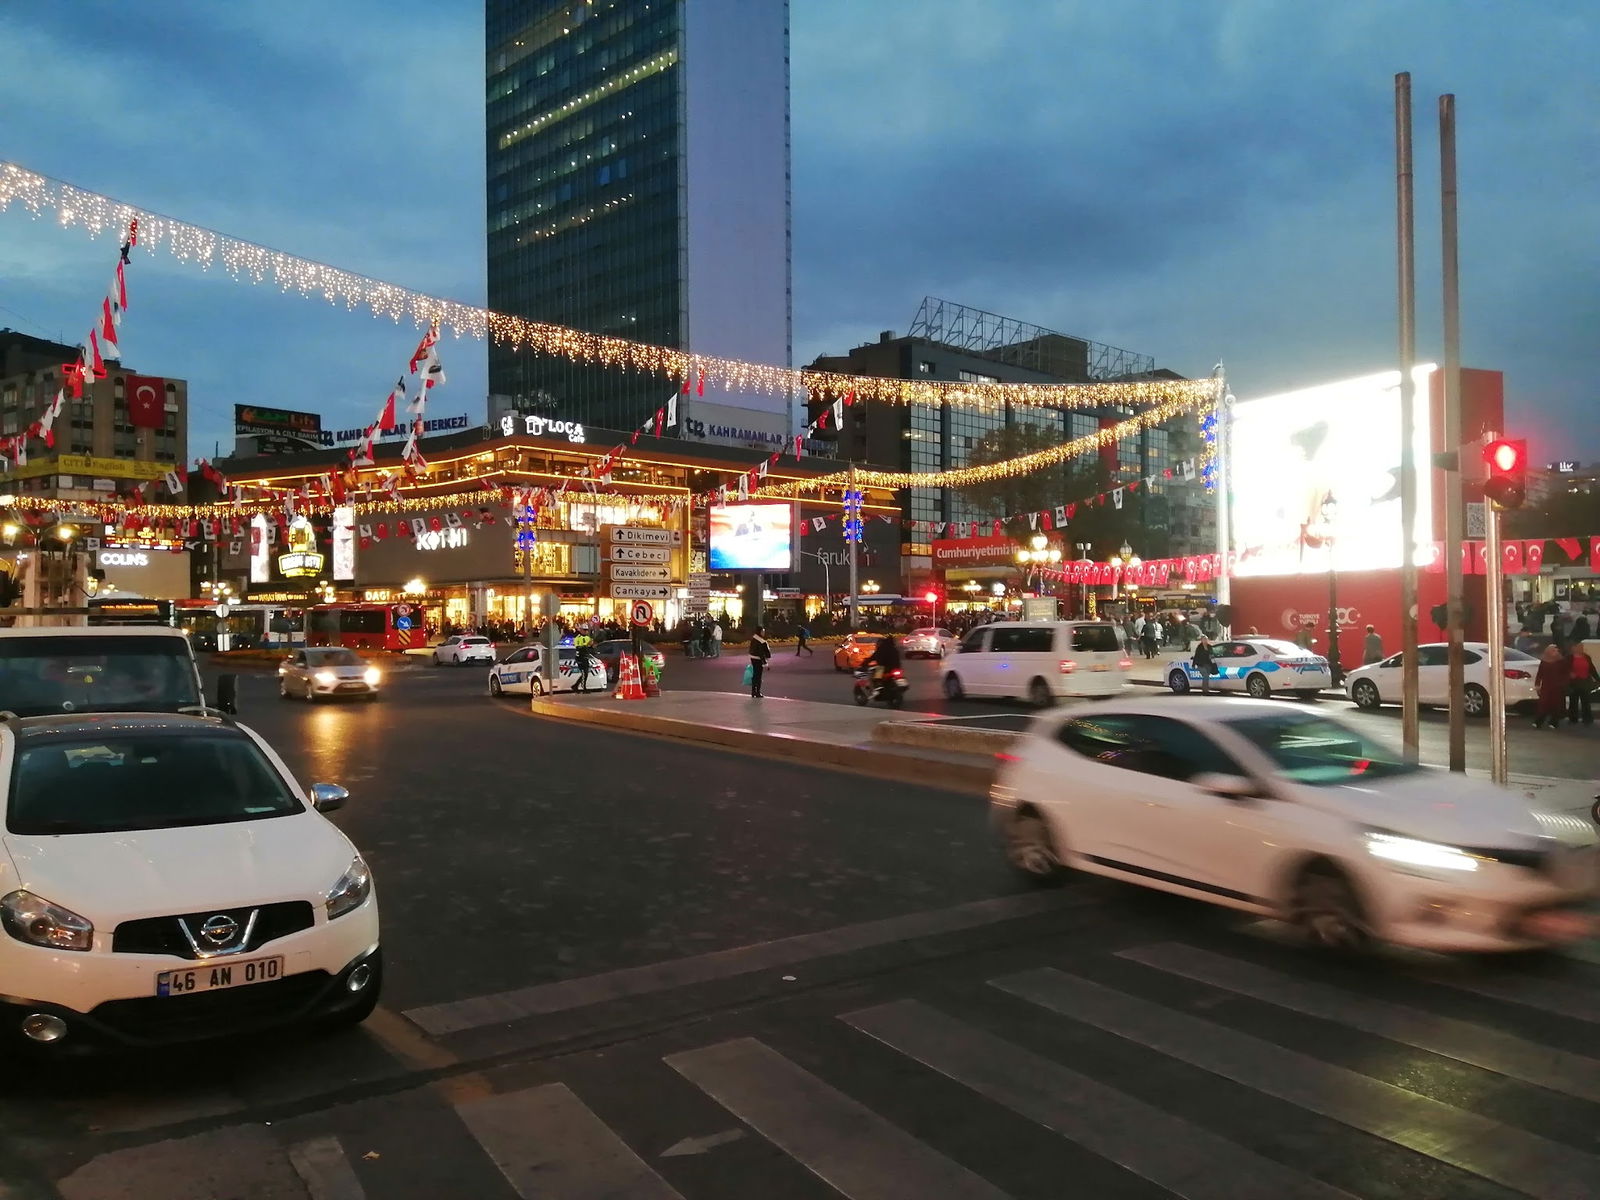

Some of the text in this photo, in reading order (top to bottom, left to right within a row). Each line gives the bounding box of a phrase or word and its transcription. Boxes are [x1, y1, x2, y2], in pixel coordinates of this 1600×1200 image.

[709, 424, 782, 445] KAHRAMANLAR
[627, 531, 669, 541] Dikimevi
[627, 550, 666, 560] Cebeci
[816, 547, 851, 566] faruk
[615, 586, 657, 597] Çankaya
[172, 959, 278, 992] 46 AN 010
